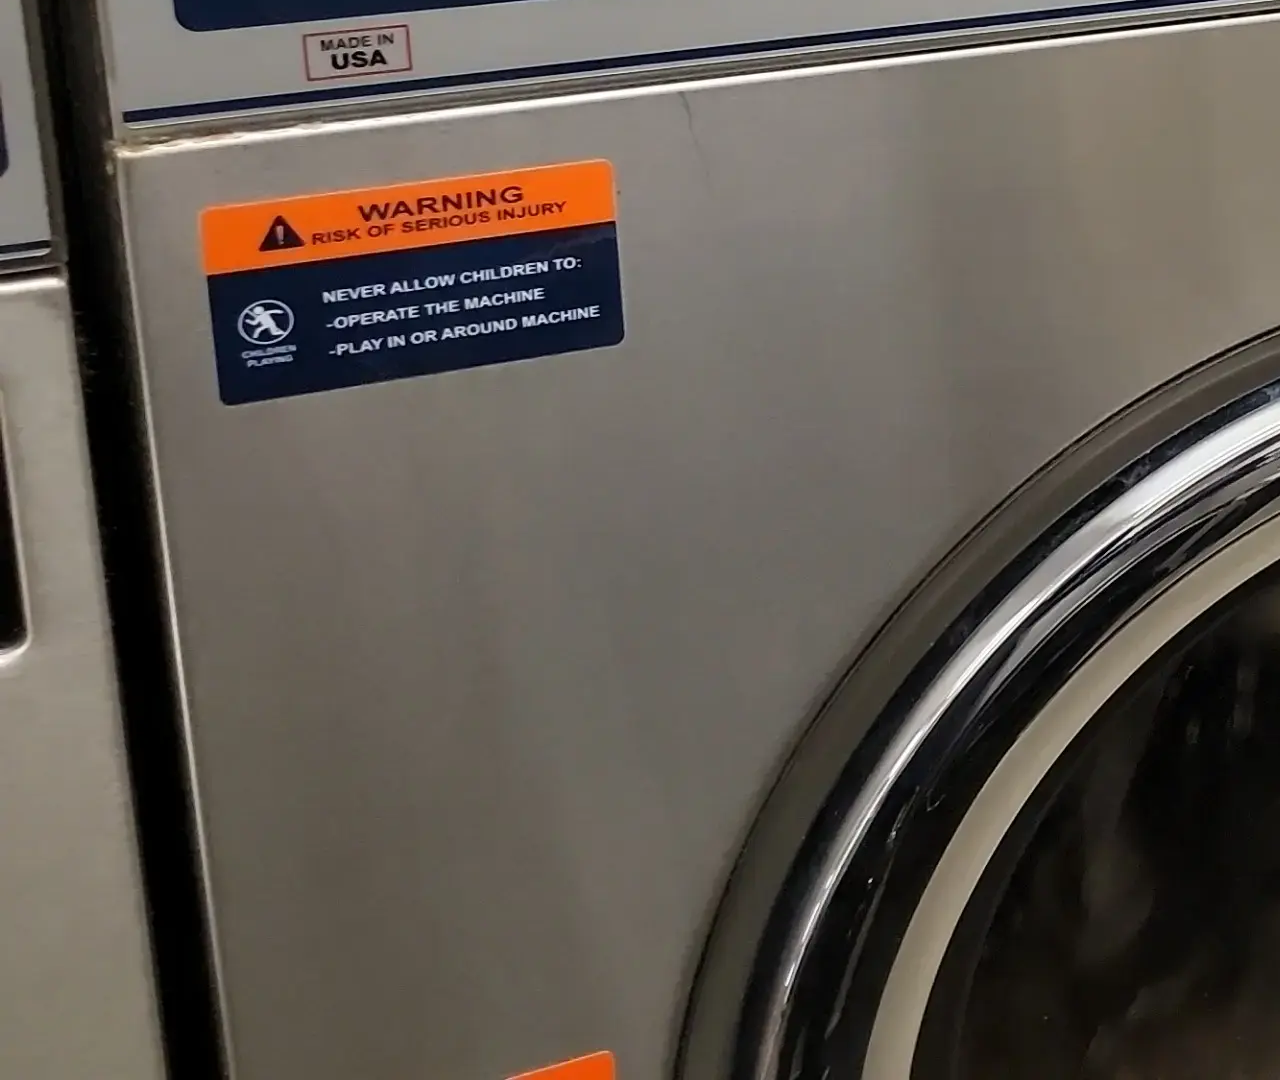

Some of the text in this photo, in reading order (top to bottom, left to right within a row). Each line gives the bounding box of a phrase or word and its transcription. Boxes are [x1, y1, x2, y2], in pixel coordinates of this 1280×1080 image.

[320, 32, 395, 52] MADE IN
[331, 48, 388, 71] USA
[311, 200, 568, 246] RISK OF SERIOUS INJURY
[357, 185, 524, 222] WARNING
[321, 281, 387, 304] NEVER
[389, 273, 457, 296] ALLOW
[459, 260, 550, 286] CHILDREN
[325, 287, 546, 331] -OPERATE THE MACHINE
[327, 304, 602, 358] -PLAY IN OR AROUND MACHINE
[241, 343, 298, 361] CHILDREN
